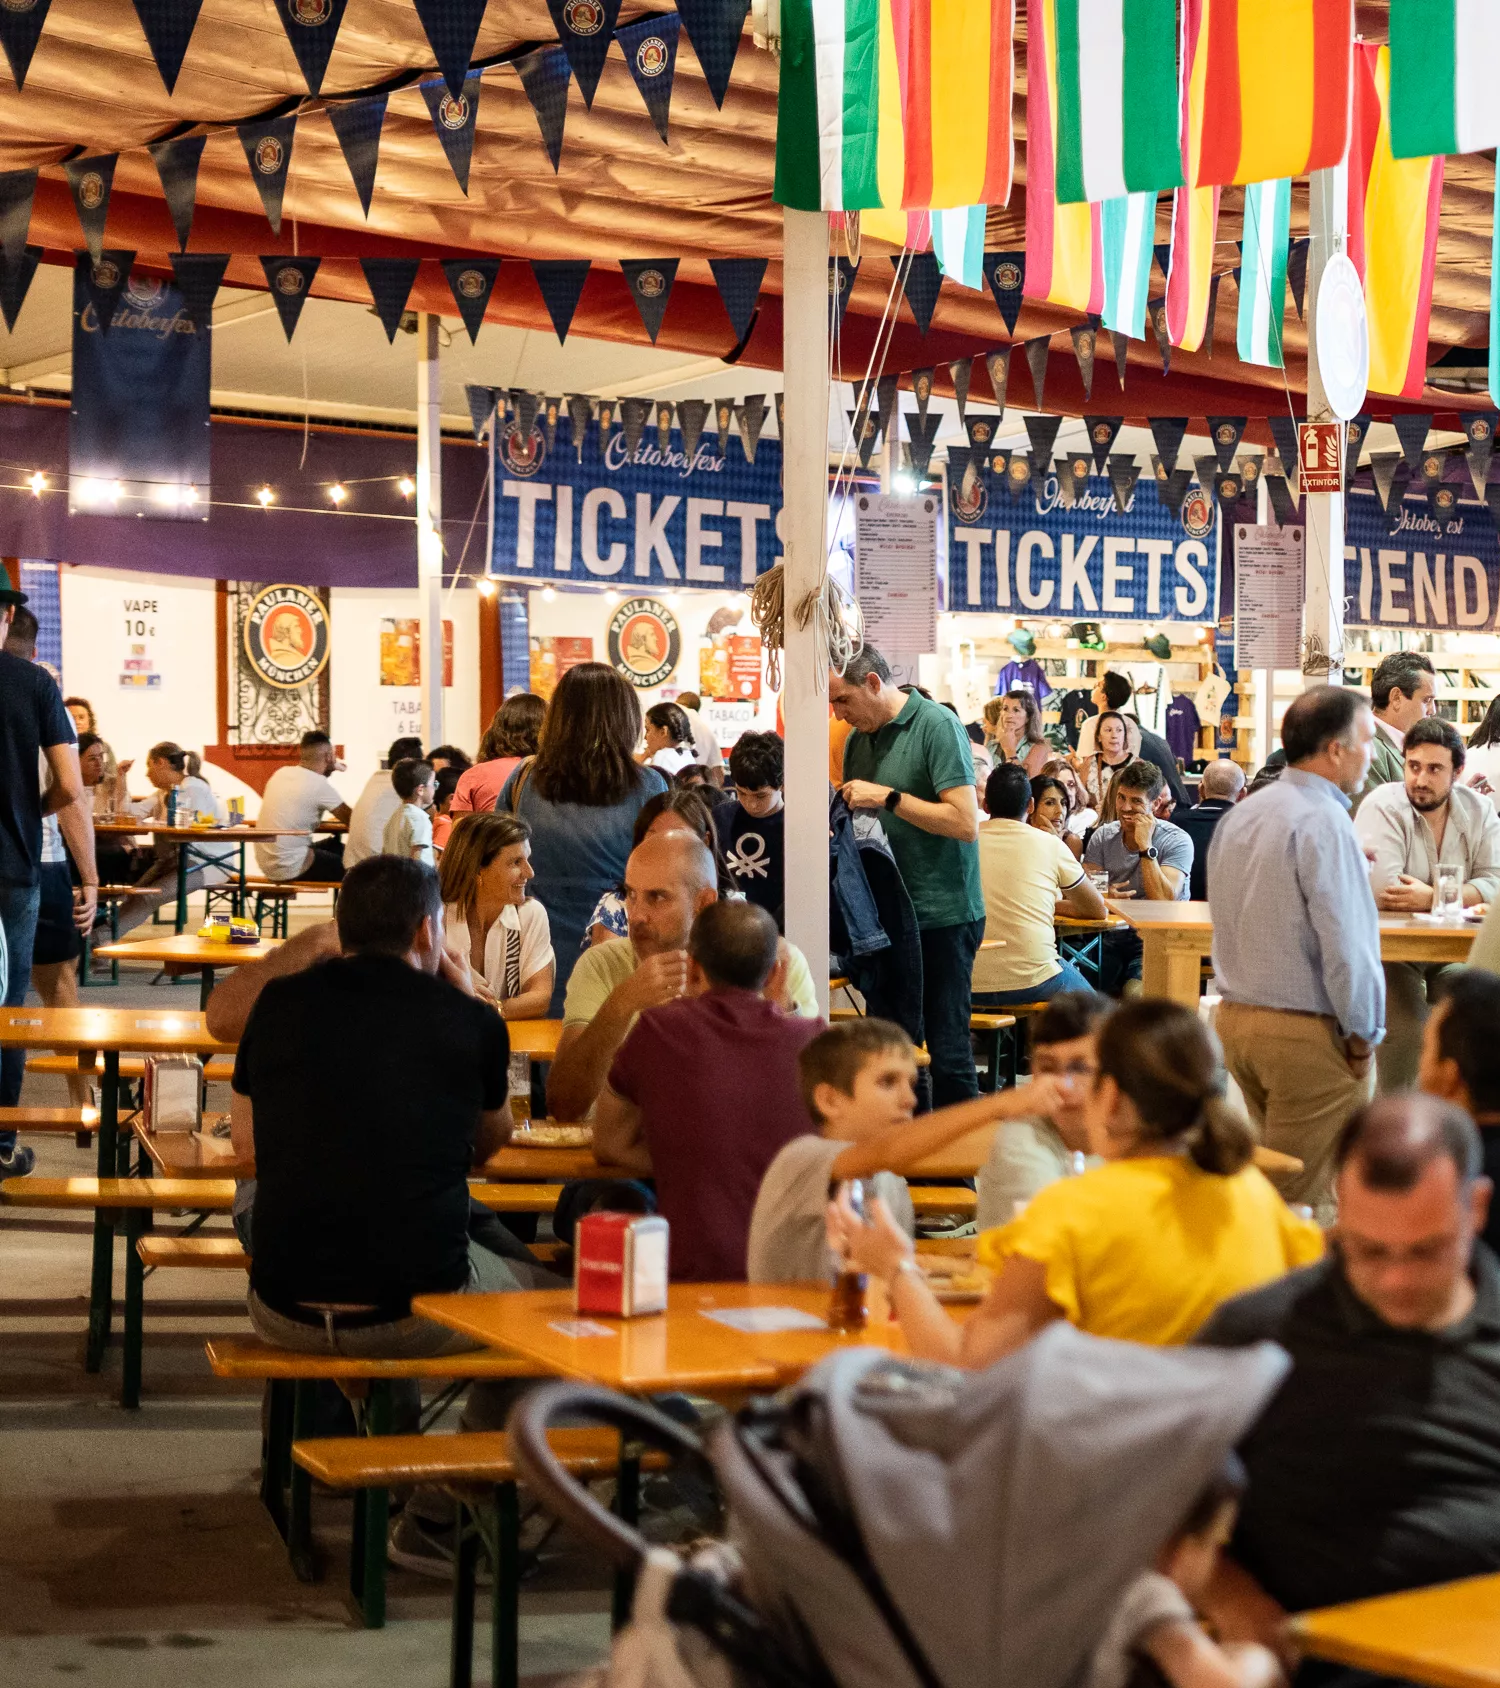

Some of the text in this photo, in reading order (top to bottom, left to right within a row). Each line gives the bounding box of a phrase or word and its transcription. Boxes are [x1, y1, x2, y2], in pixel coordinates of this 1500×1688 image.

[638, 38, 666, 57] PAULANER
[80, 301, 197, 341] Otoberfes
[1302, 478, 1340, 487] EXTINTOR
[1035, 476, 1136, 520] Okoberft
[502, 480, 784, 585] TICKET
[954, 526, 1209, 617] TICKETS
[123, 599, 159, 613] VAPE
[250, 588, 324, 625] PAULANER
[611, 598, 677, 635] PAULANER
[124, 619, 156, 637] 10 €
[256, 656, 321, 684] MÜNCHEN
[616, 661, 673, 687] MÜNCHEN
[392, 701, 422, 714] TABA
[708, 708, 750, 722] TABACO
[397, 722, 404, 734] 6
